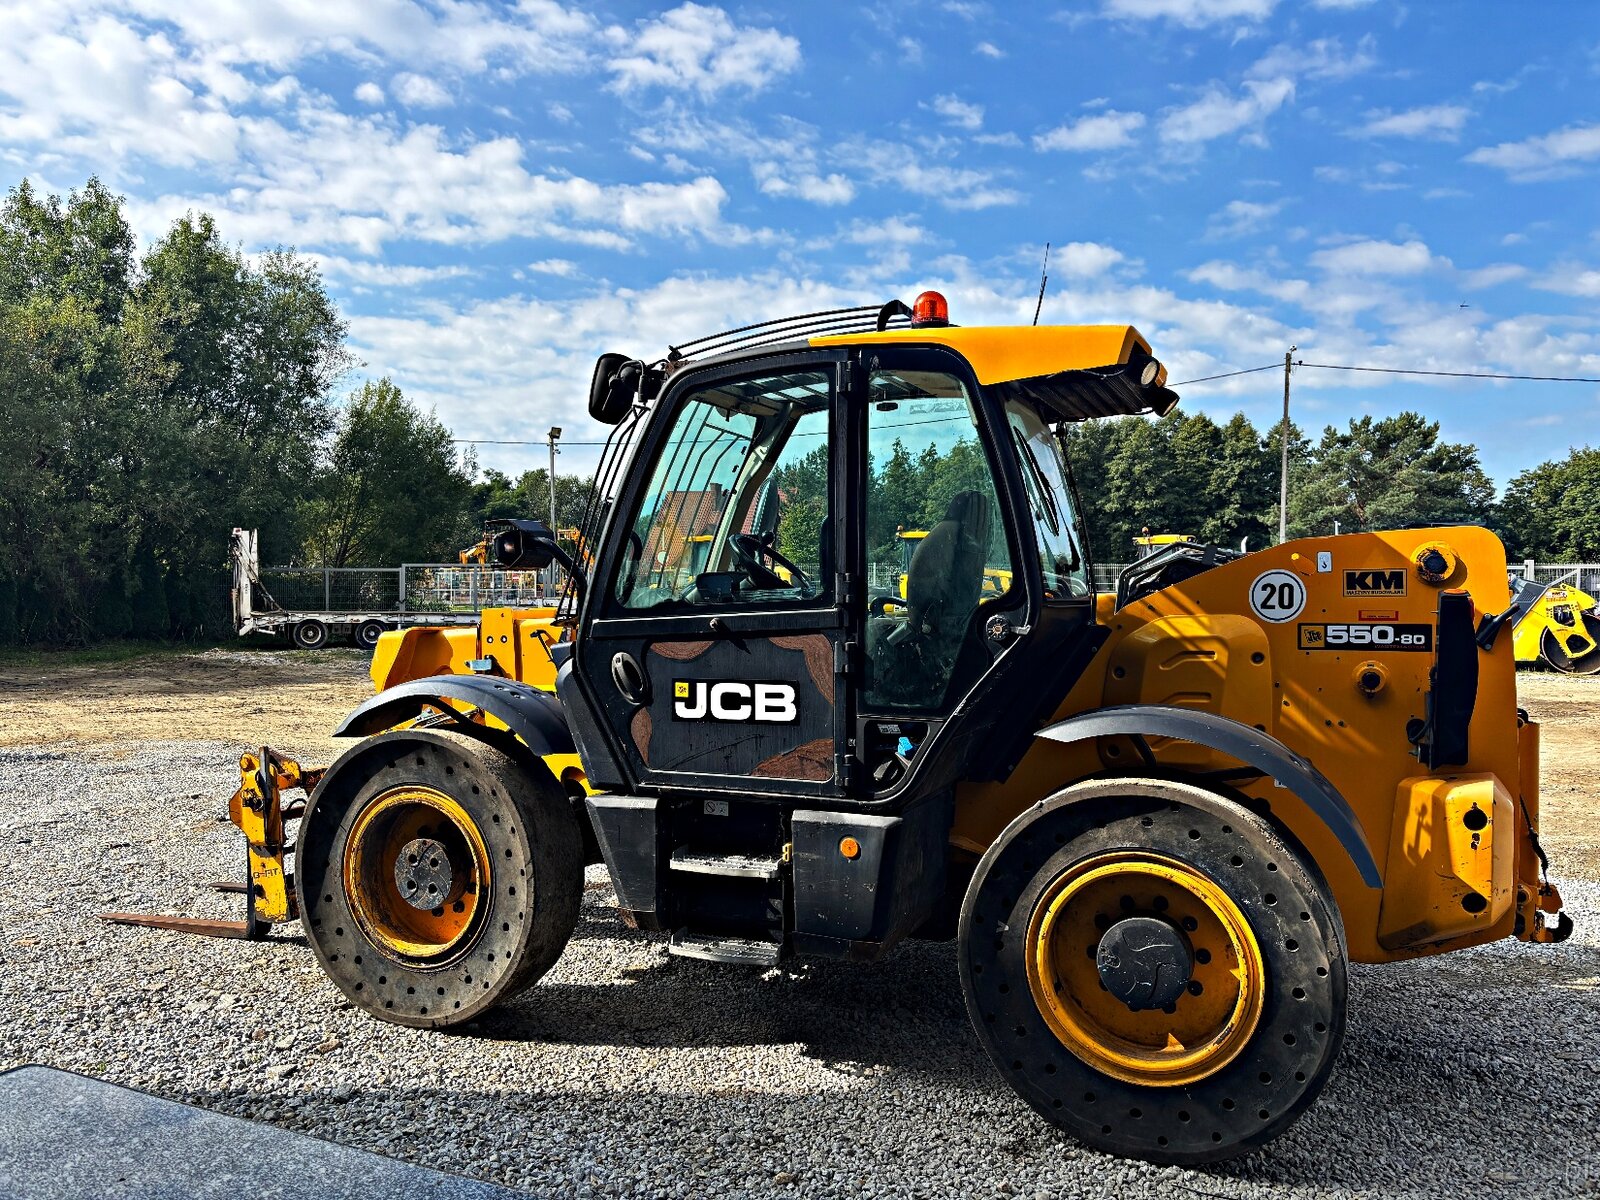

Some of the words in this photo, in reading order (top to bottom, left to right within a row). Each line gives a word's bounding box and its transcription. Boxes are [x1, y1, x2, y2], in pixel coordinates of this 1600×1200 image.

[1346, 571, 1404, 590] KM
[1260, 582, 1294, 609] 20
[1326, 625, 1425, 645] 550-80
[674, 682, 797, 722] JCB
